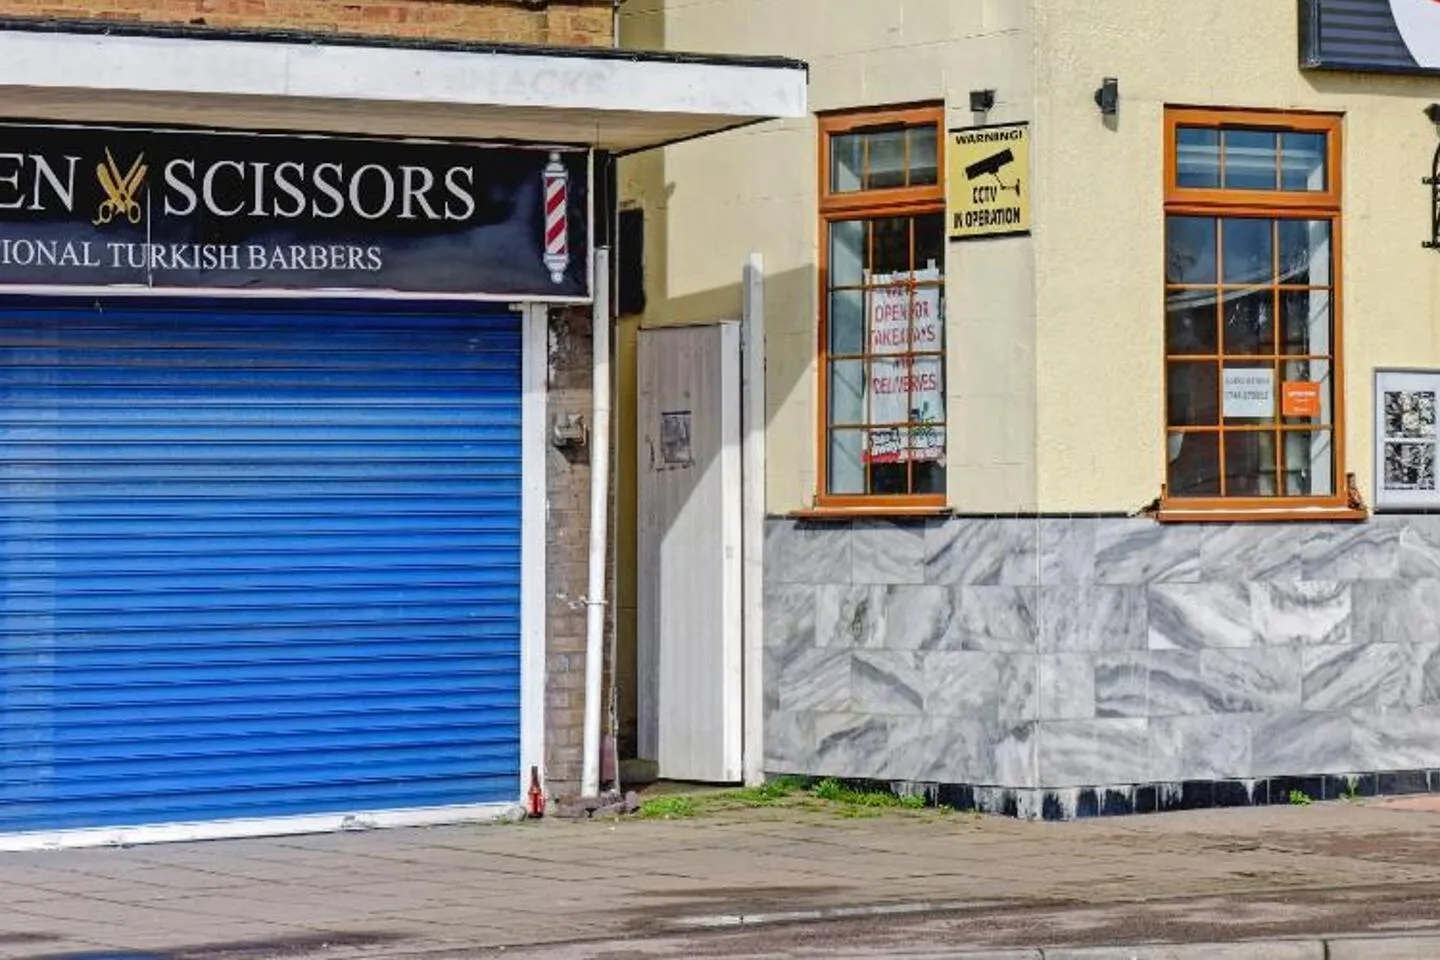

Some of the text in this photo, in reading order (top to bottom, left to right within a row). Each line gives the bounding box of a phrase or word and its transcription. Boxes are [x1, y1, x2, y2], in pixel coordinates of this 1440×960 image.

[955, 130, 1022, 145] WARNING!
[164, 159, 475, 220] SCISSORS
[972, 186, 998, 204] CCTV
[954, 207, 1020, 229] IN OPERATION
[107, 243, 240, 270] TURKISH
[248, 245, 383, 271] BARBERS
